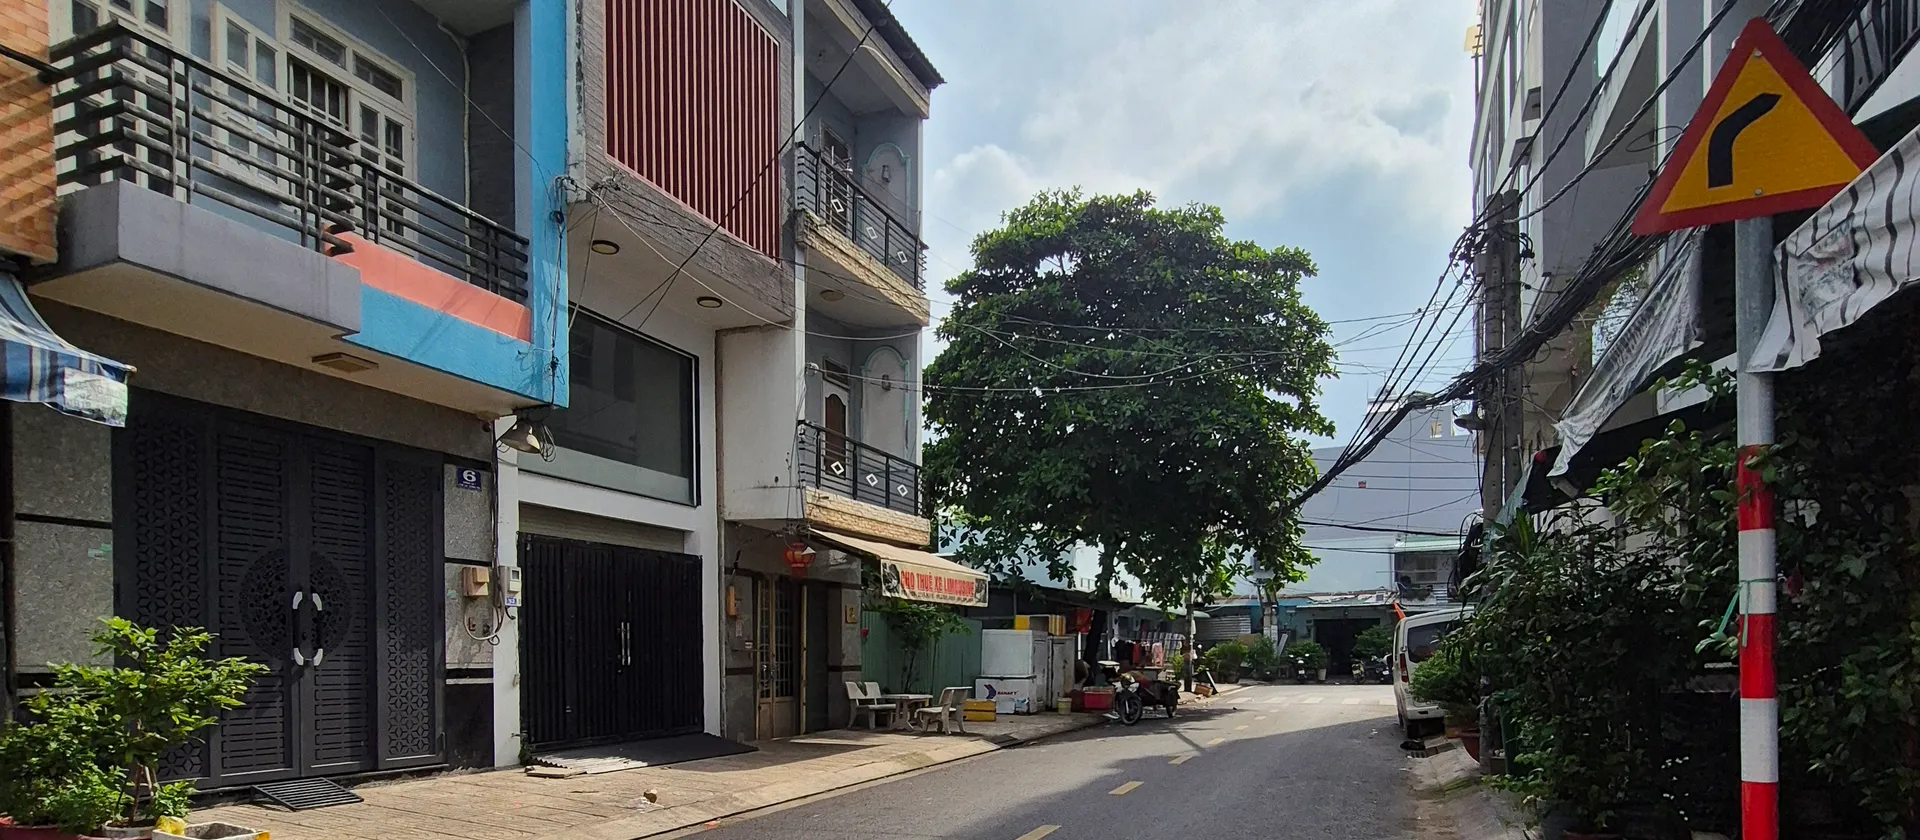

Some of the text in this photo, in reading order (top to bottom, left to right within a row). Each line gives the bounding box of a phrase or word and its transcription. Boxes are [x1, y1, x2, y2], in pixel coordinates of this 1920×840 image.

[462, 470, 477, 482] 6
[900, 570, 915, 590] CHO
[934, 575, 943, 593] XE
